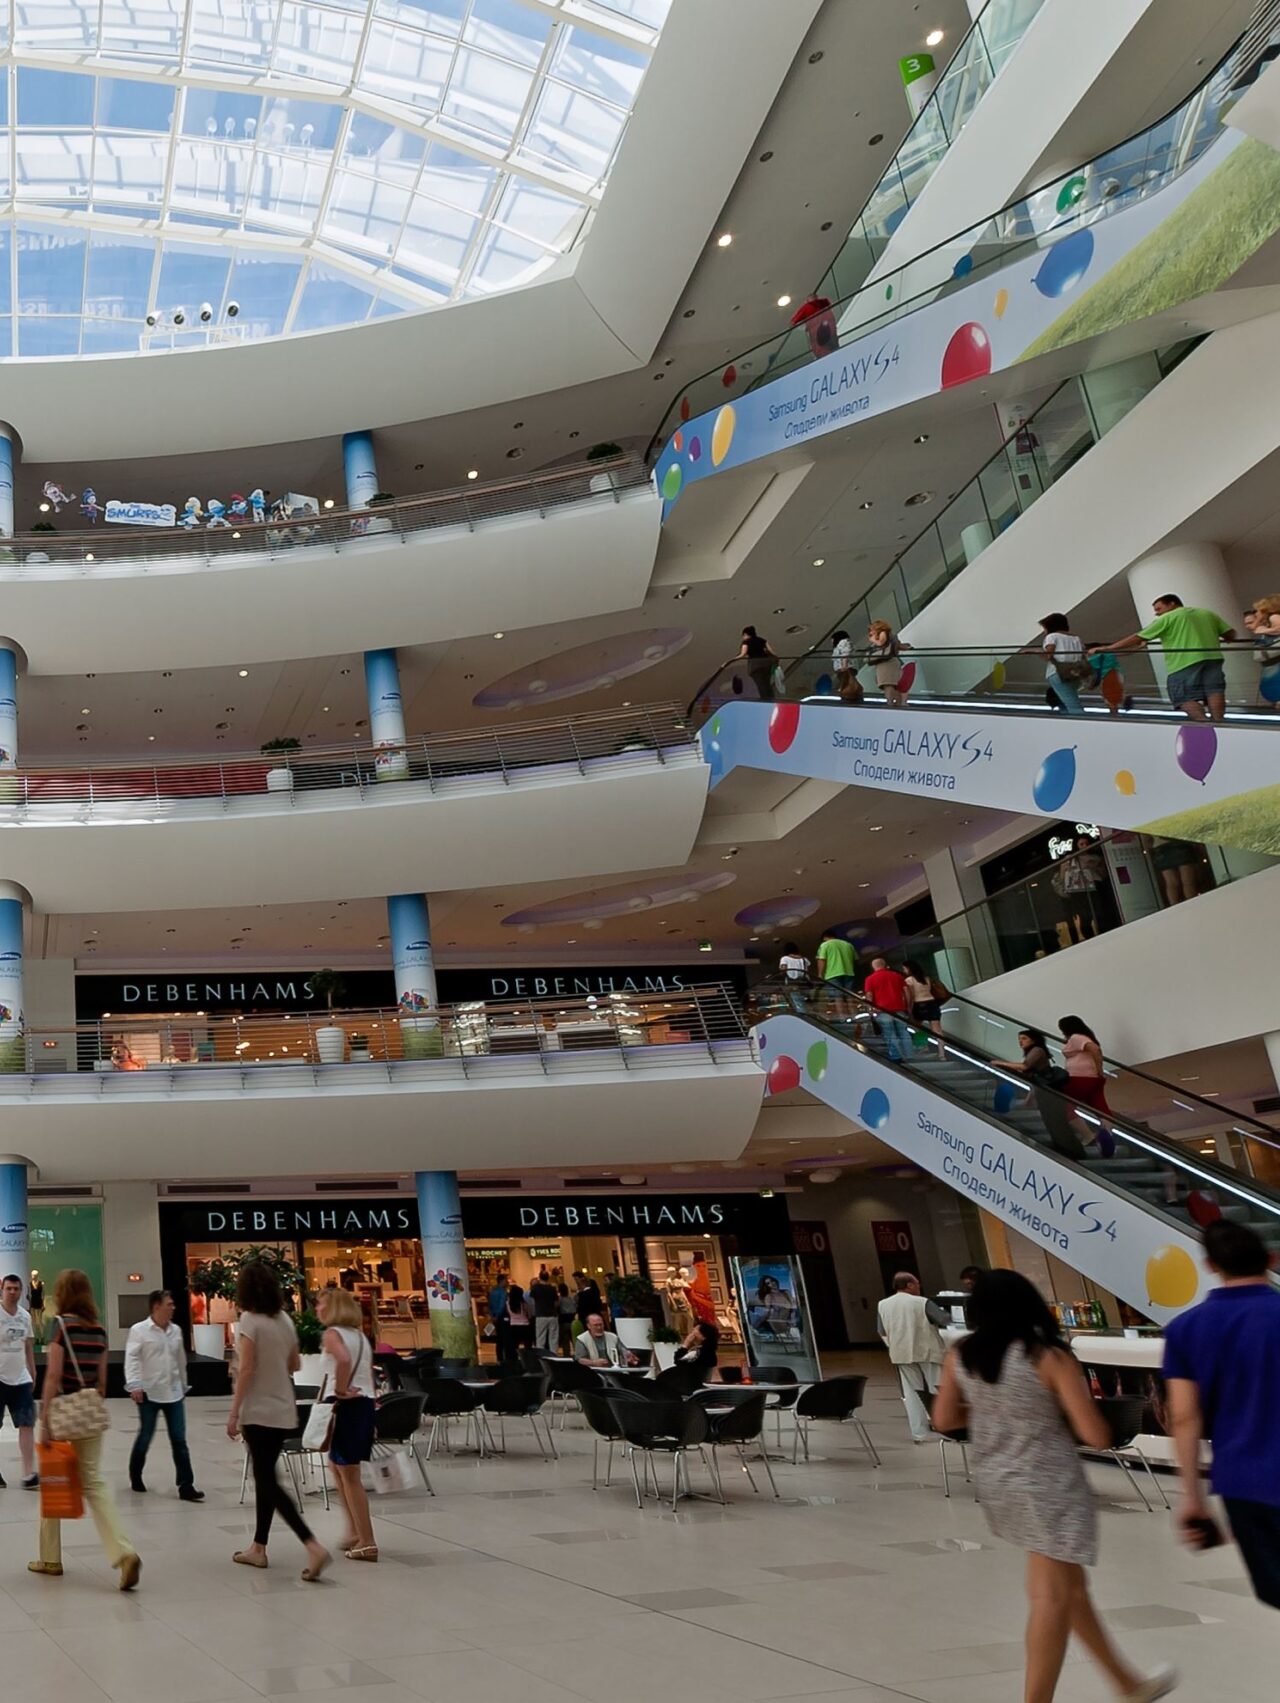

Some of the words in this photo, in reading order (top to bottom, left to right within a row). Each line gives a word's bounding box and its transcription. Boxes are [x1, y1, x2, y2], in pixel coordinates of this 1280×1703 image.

[906, 58, 921, 73] 3
[768, 394, 807, 421] Samsung
[810, 354, 872, 404] GALAXY
[784, 413, 828, 439] Сподели
[829, 395, 870, 422] живота
[832, 731, 879, 756] Samsung
[883, 728, 961, 759] GALAXY
[854, 759, 905, 782] Сподели
[907, 770, 956, 790] живота
[123, 982, 315, 1002] DEBENHAMS
[491, 975, 685, 996] DEBENHAMS
[917, 1111, 975, 1164] Samsung
[979, 1143, 1074, 1215] GALAXY
[520, 1204, 724, 1227] DEBENHAMS
[943, 1156, 1007, 1210] Сподели
[1008, 1200, 1069, 1250] живота
[208, 1209, 410, 1231] DEBENHAMS
[897, 1232, 910, 1251] 0
